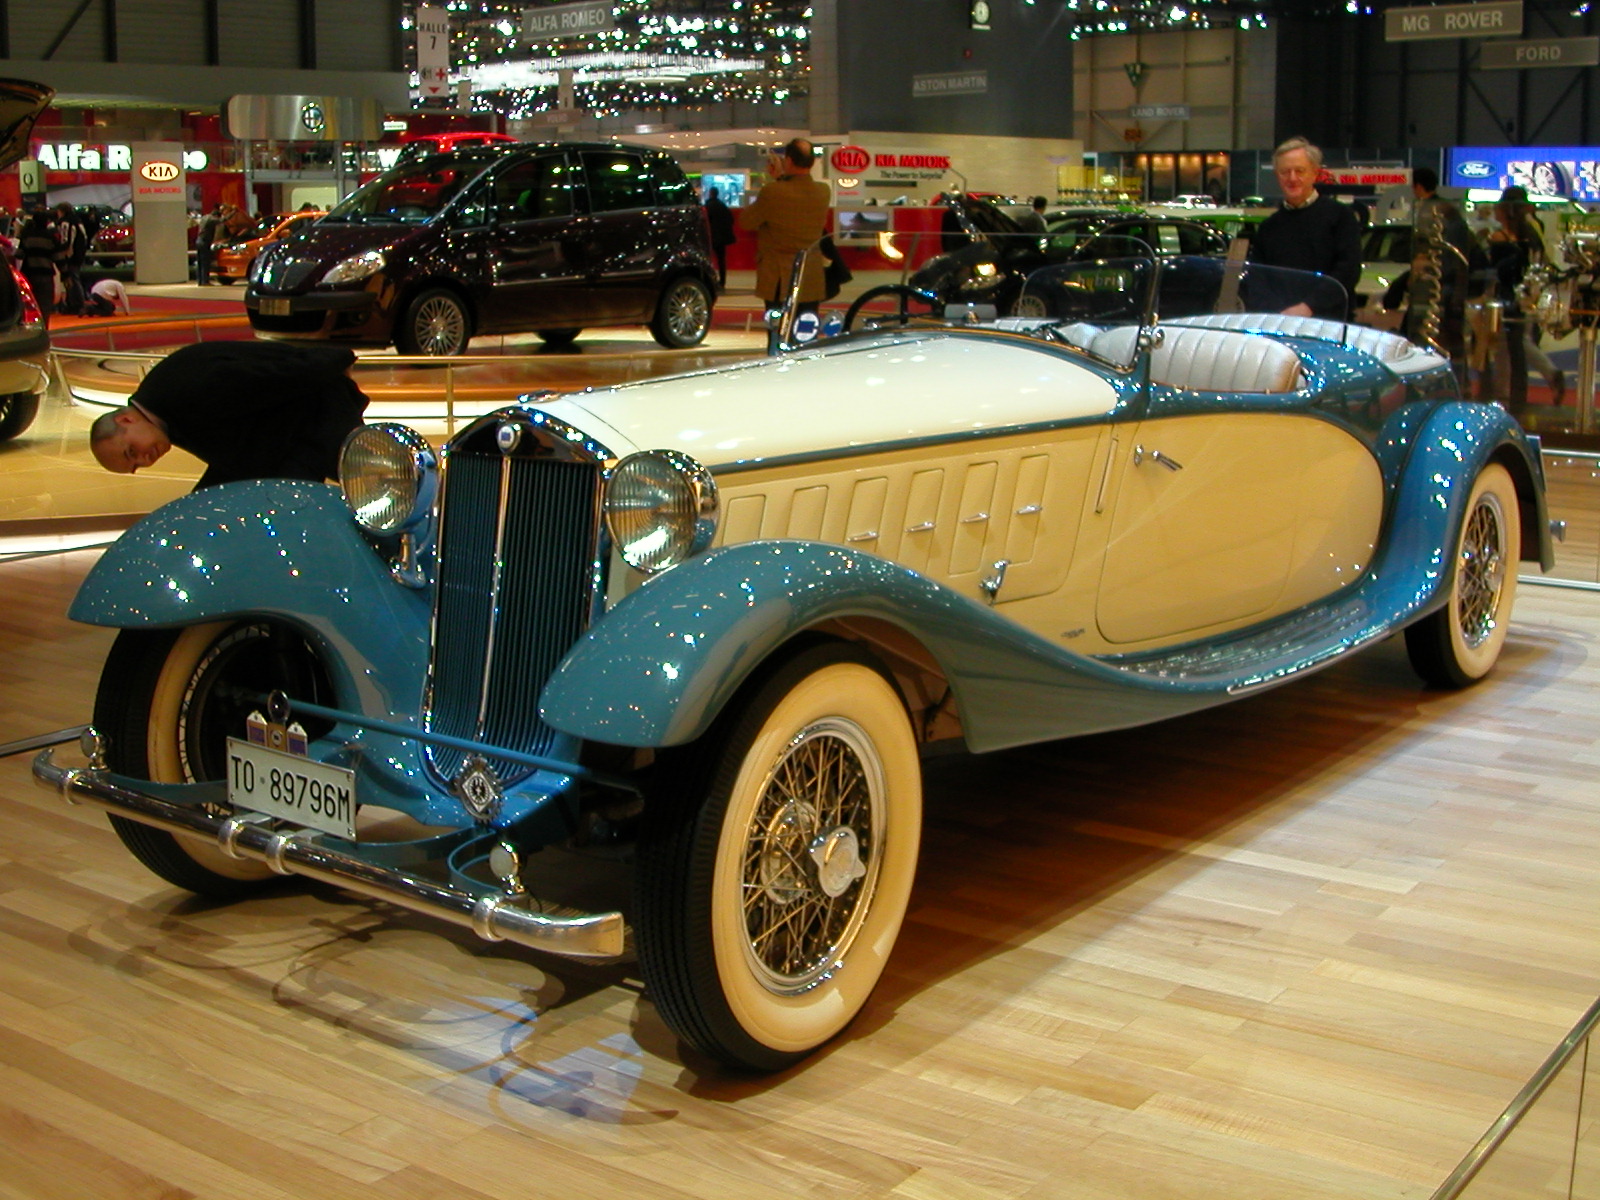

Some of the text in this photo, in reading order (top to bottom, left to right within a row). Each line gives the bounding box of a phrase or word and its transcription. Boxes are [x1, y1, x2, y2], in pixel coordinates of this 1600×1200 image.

[530, 9, 605, 32] ALFA ROMEO
[1402, 11, 1503, 32] MG ROVER
[419, 22, 447, 34] HALLE
[430, 35, 437, 49] 7
[1516, 47, 1561, 61] FORD
[913, 76, 987, 90] ASTON MARTIN
[37, 143, 101, 170] Alfa
[838, 152, 864, 166] KIA
[875, 154, 950, 168] KIA MOTORS
[148, 166, 173, 177] KIA
[231, 755, 351, 824] TO 89796M
